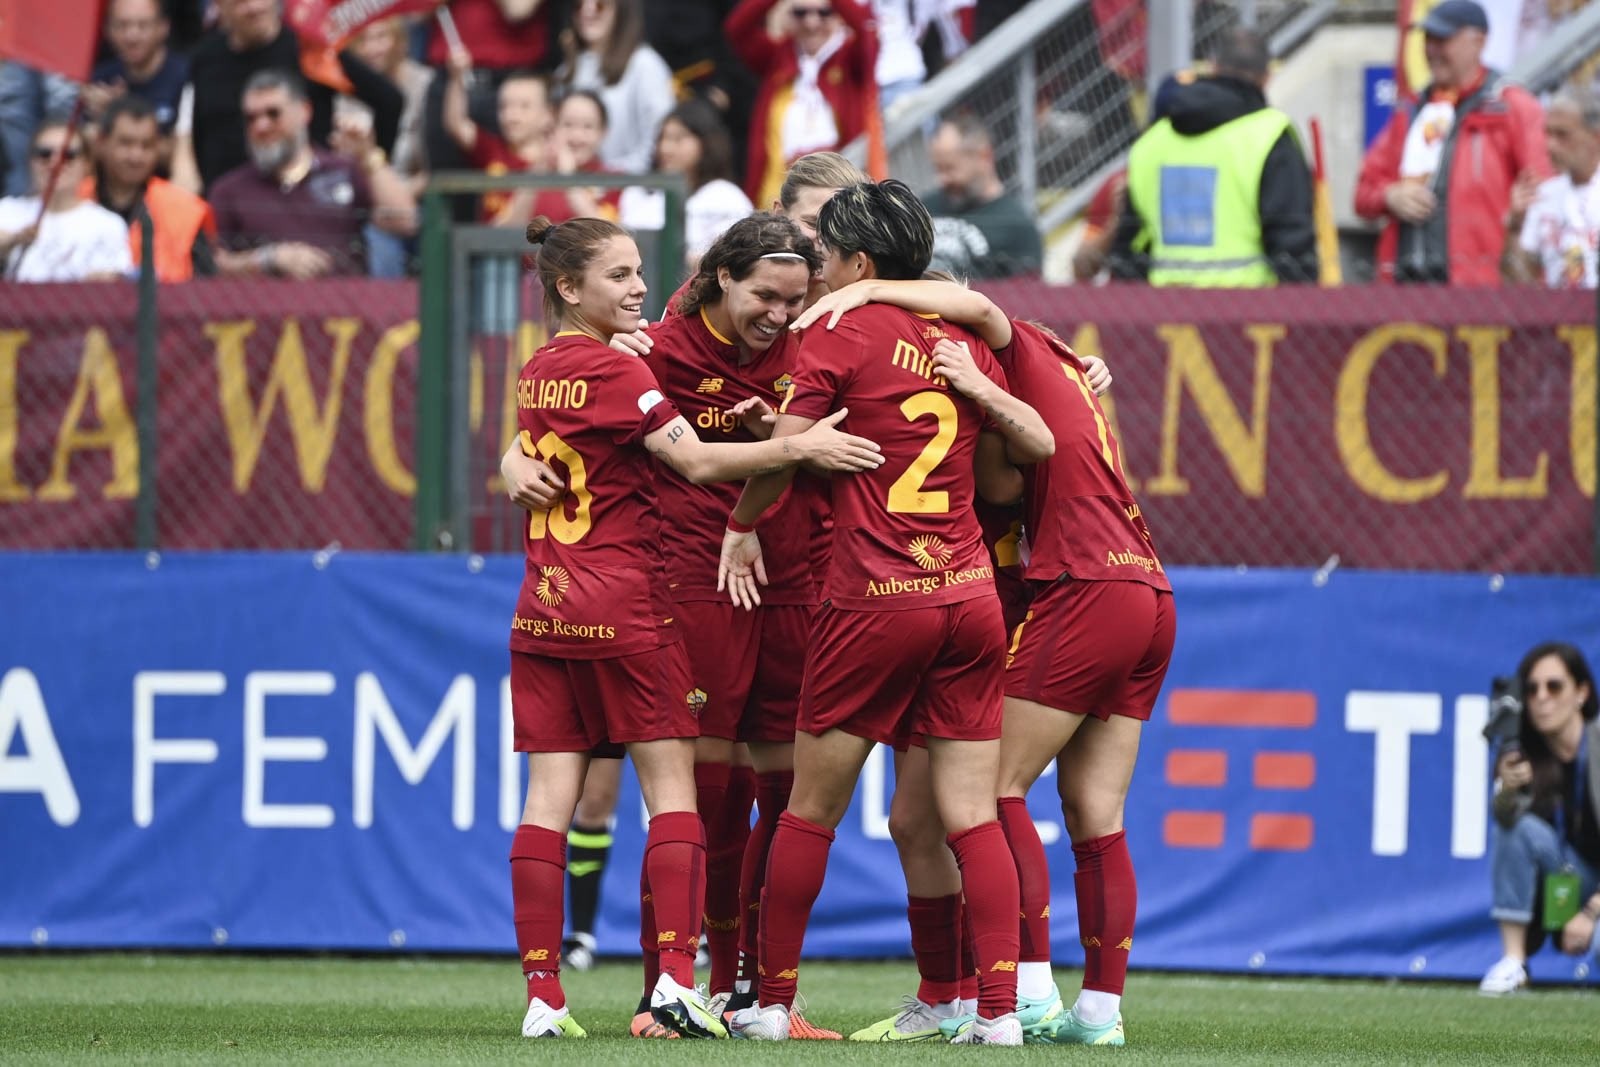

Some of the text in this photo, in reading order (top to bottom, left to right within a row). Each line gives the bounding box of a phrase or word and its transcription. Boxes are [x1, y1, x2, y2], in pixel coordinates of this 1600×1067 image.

[887, 391, 958, 514] 2
[865, 565, 994, 597] Auberge Resorts
[552, 617, 616, 640] Resorts
